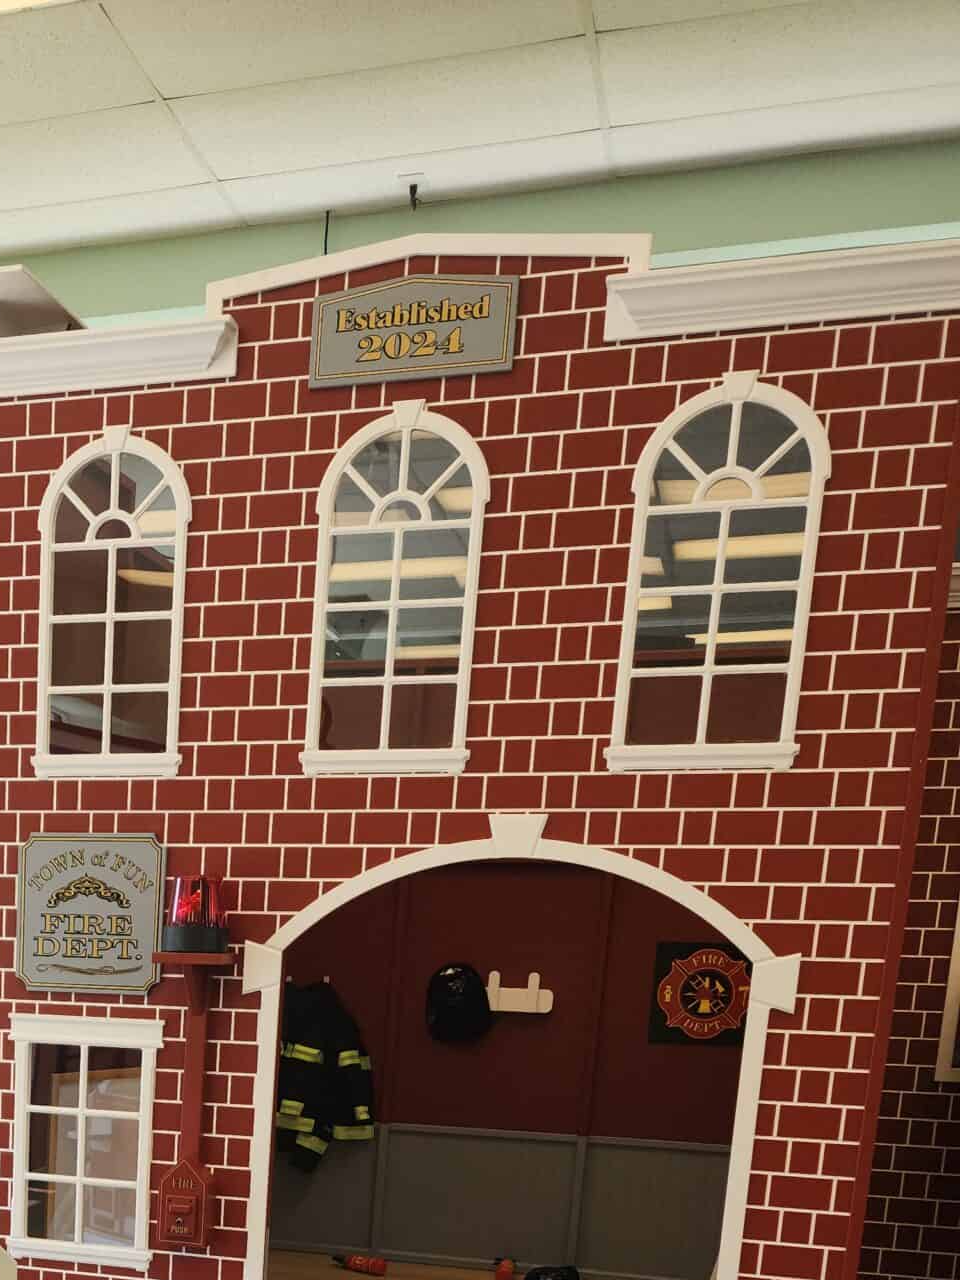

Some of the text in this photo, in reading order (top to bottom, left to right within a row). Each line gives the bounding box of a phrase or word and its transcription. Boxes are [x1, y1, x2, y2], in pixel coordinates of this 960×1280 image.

[335, 294, 492, 333] Established
[355, 326, 464, 362] 2024
[28, 848, 86, 892] TOWN
[110, 852, 155, 894] FUN
[40, 912, 134, 936] FIRE
[33, 936, 144, 961] DEPT.
[692, 954, 727, 967] FIRE
[683, 1018, 721, 1033] DEPT
